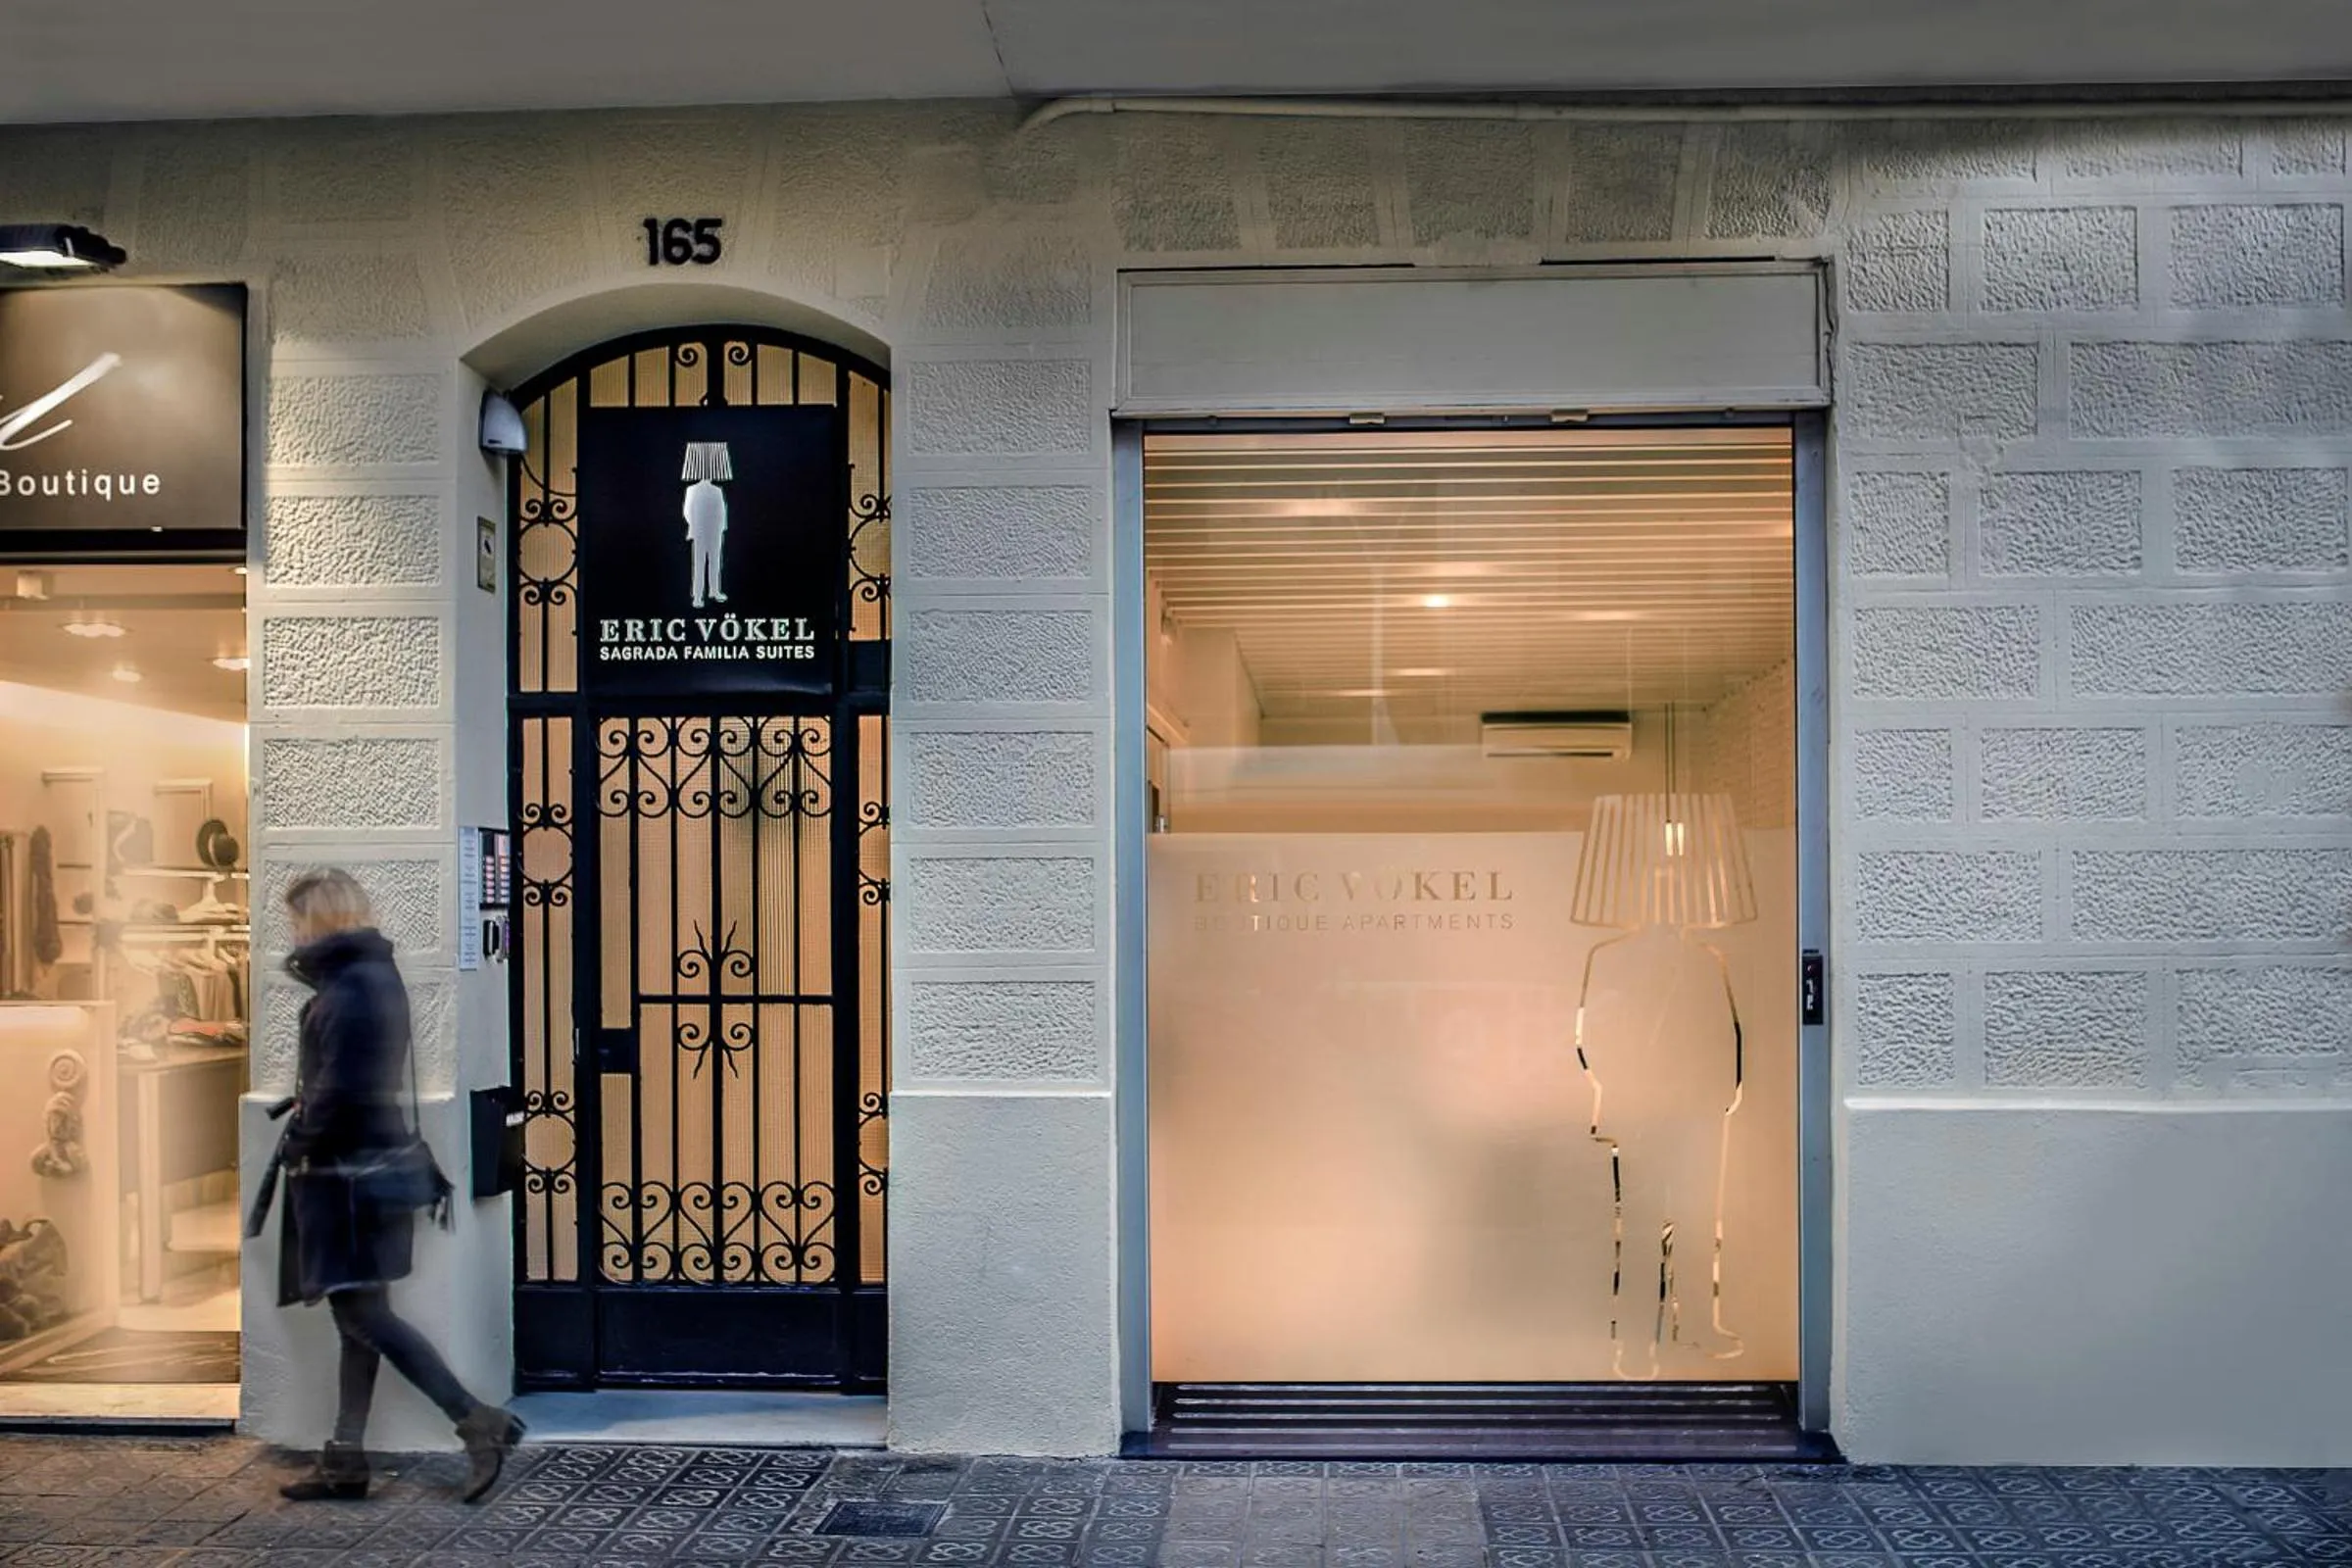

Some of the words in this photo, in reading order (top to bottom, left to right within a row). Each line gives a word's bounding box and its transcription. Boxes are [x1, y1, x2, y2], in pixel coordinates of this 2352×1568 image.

[643, 218, 723, 266] 165
[0, 468, 162, 502] Boutique
[599, 618, 686, 642] ERIC
[694, 612, 815, 642] VÖKEL
[599, 646, 679, 661] SAGRADA
[683, 645, 750, 661] FAMILIA
[755, 645, 815, 660] SUITES
[1195, 869, 1320, 904] ERIC
[1342, 912, 1514, 931] APARTMENTS
